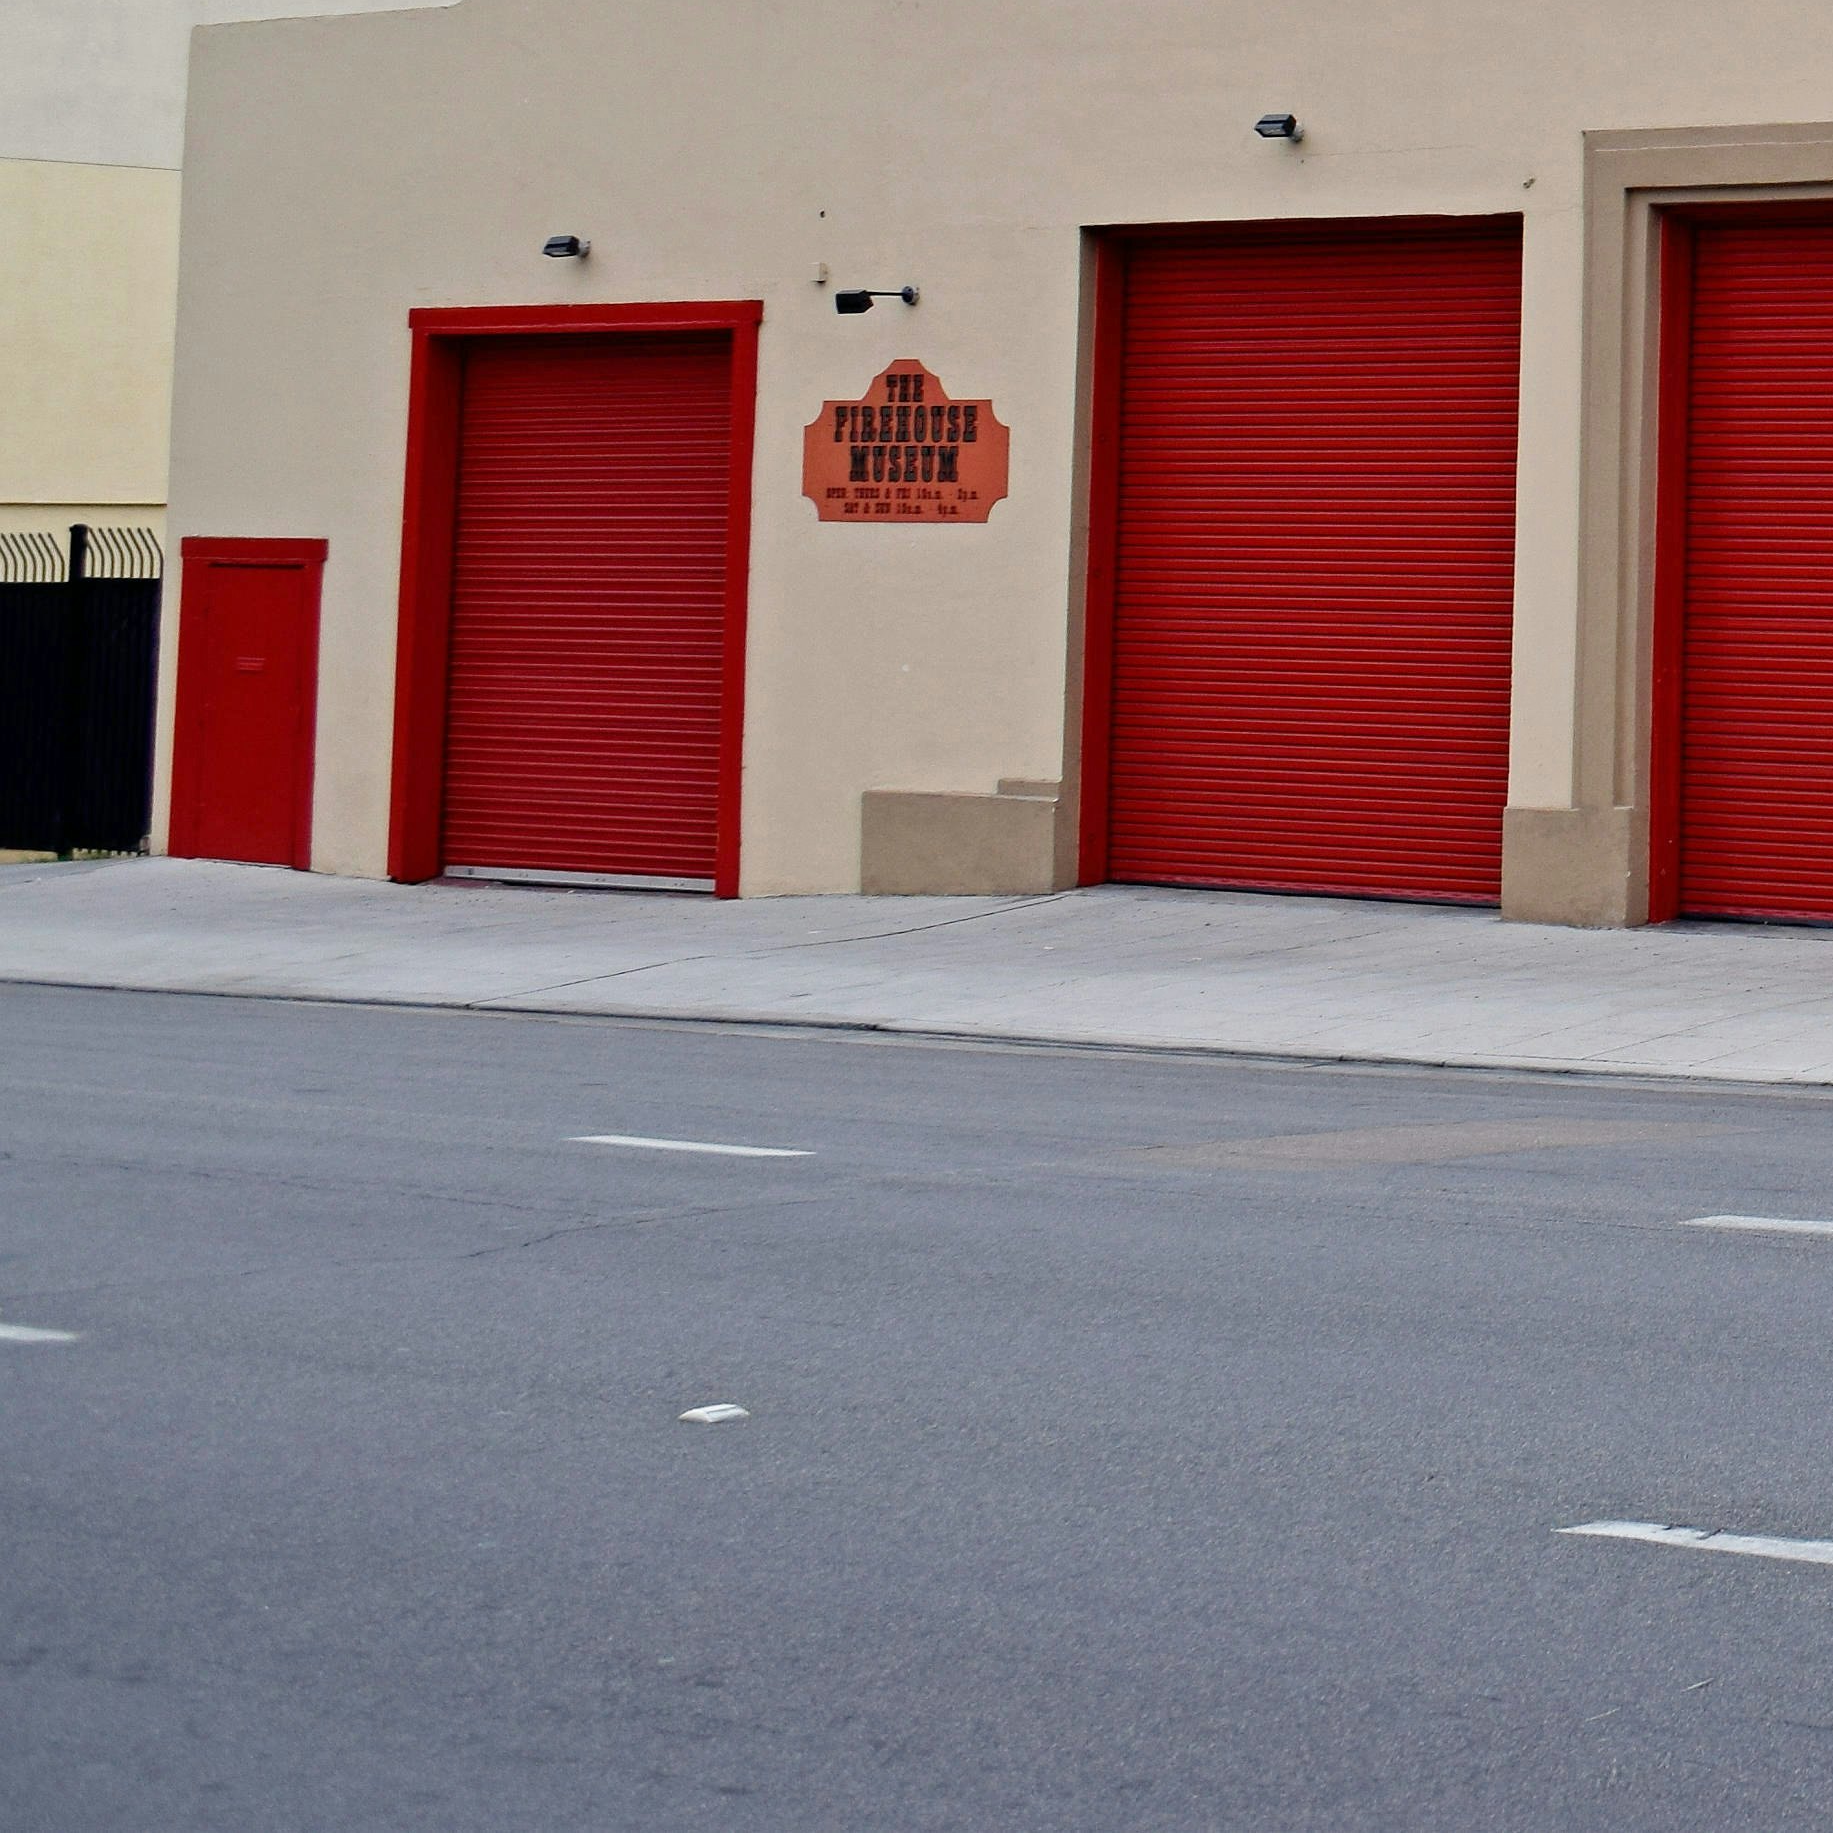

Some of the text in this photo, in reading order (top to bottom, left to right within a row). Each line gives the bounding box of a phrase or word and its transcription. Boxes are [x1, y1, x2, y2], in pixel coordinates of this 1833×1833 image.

[886, 374, 924, 402] THE
[834, 405, 978, 443] FIREHOUSE
[849, 446, 958, 483] MUSEUM
